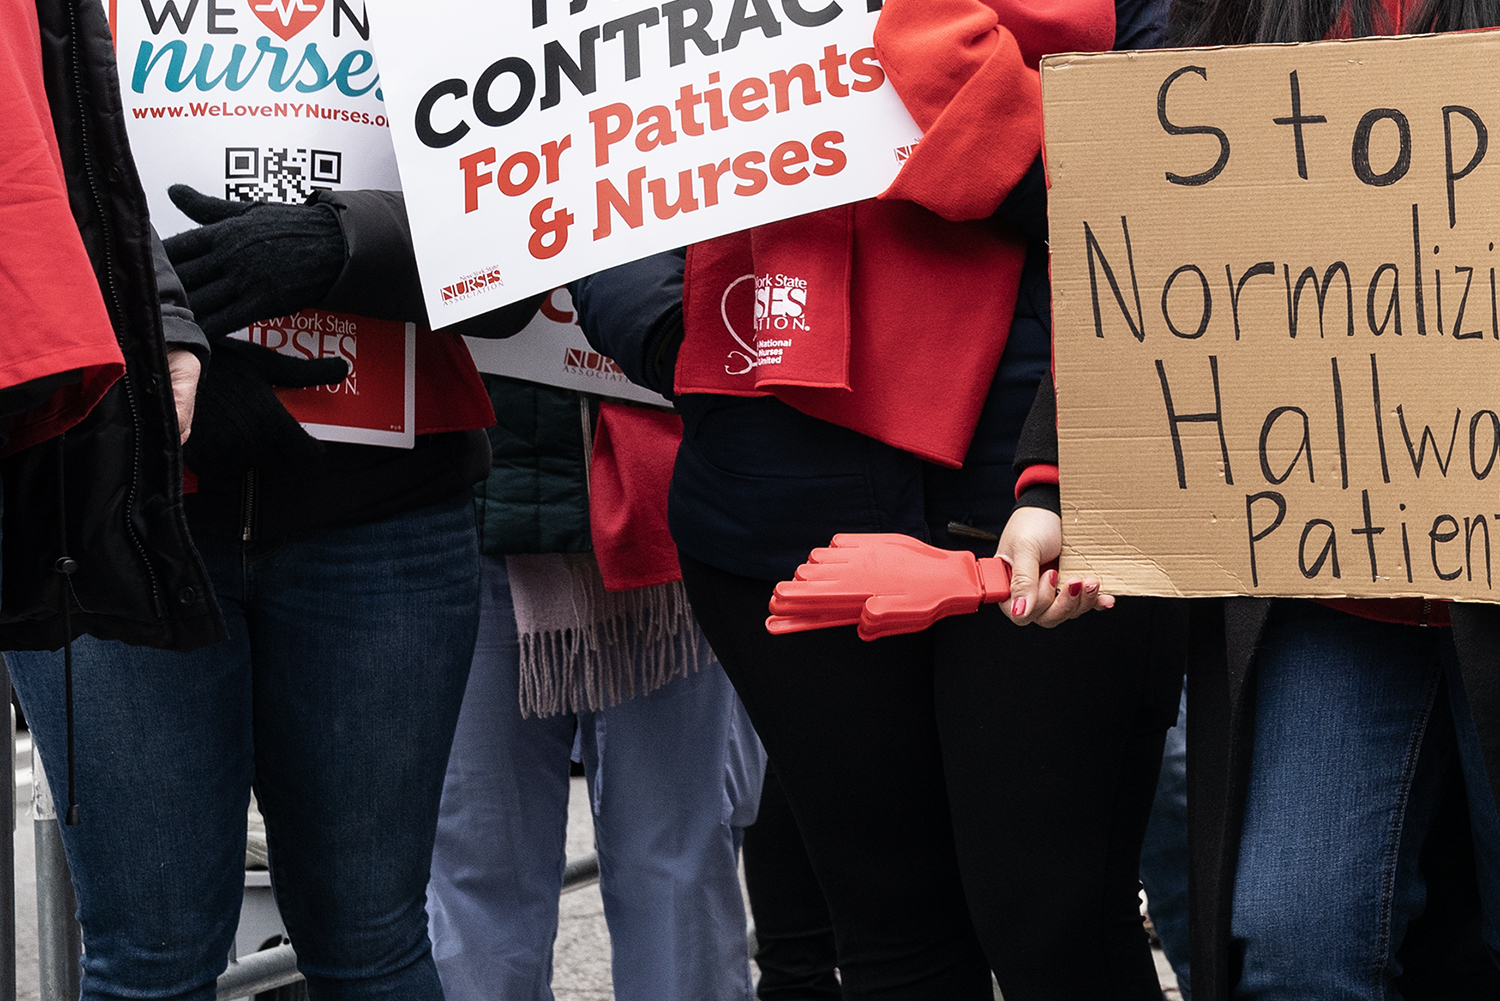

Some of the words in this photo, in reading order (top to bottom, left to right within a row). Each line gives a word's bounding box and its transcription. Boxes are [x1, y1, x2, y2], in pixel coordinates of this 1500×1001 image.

[458, 133, 572, 214] For
[588, 43, 886, 168] Patients
[1156, 66, 1488, 228] Stop
[527, 196, 575, 260] &
[593, 129, 848, 242] Nurses
[439, 269, 501, 302] NURSES
[775, 273, 807, 288] State
[290, 312, 322, 331] York
[326, 315, 357, 335] State
